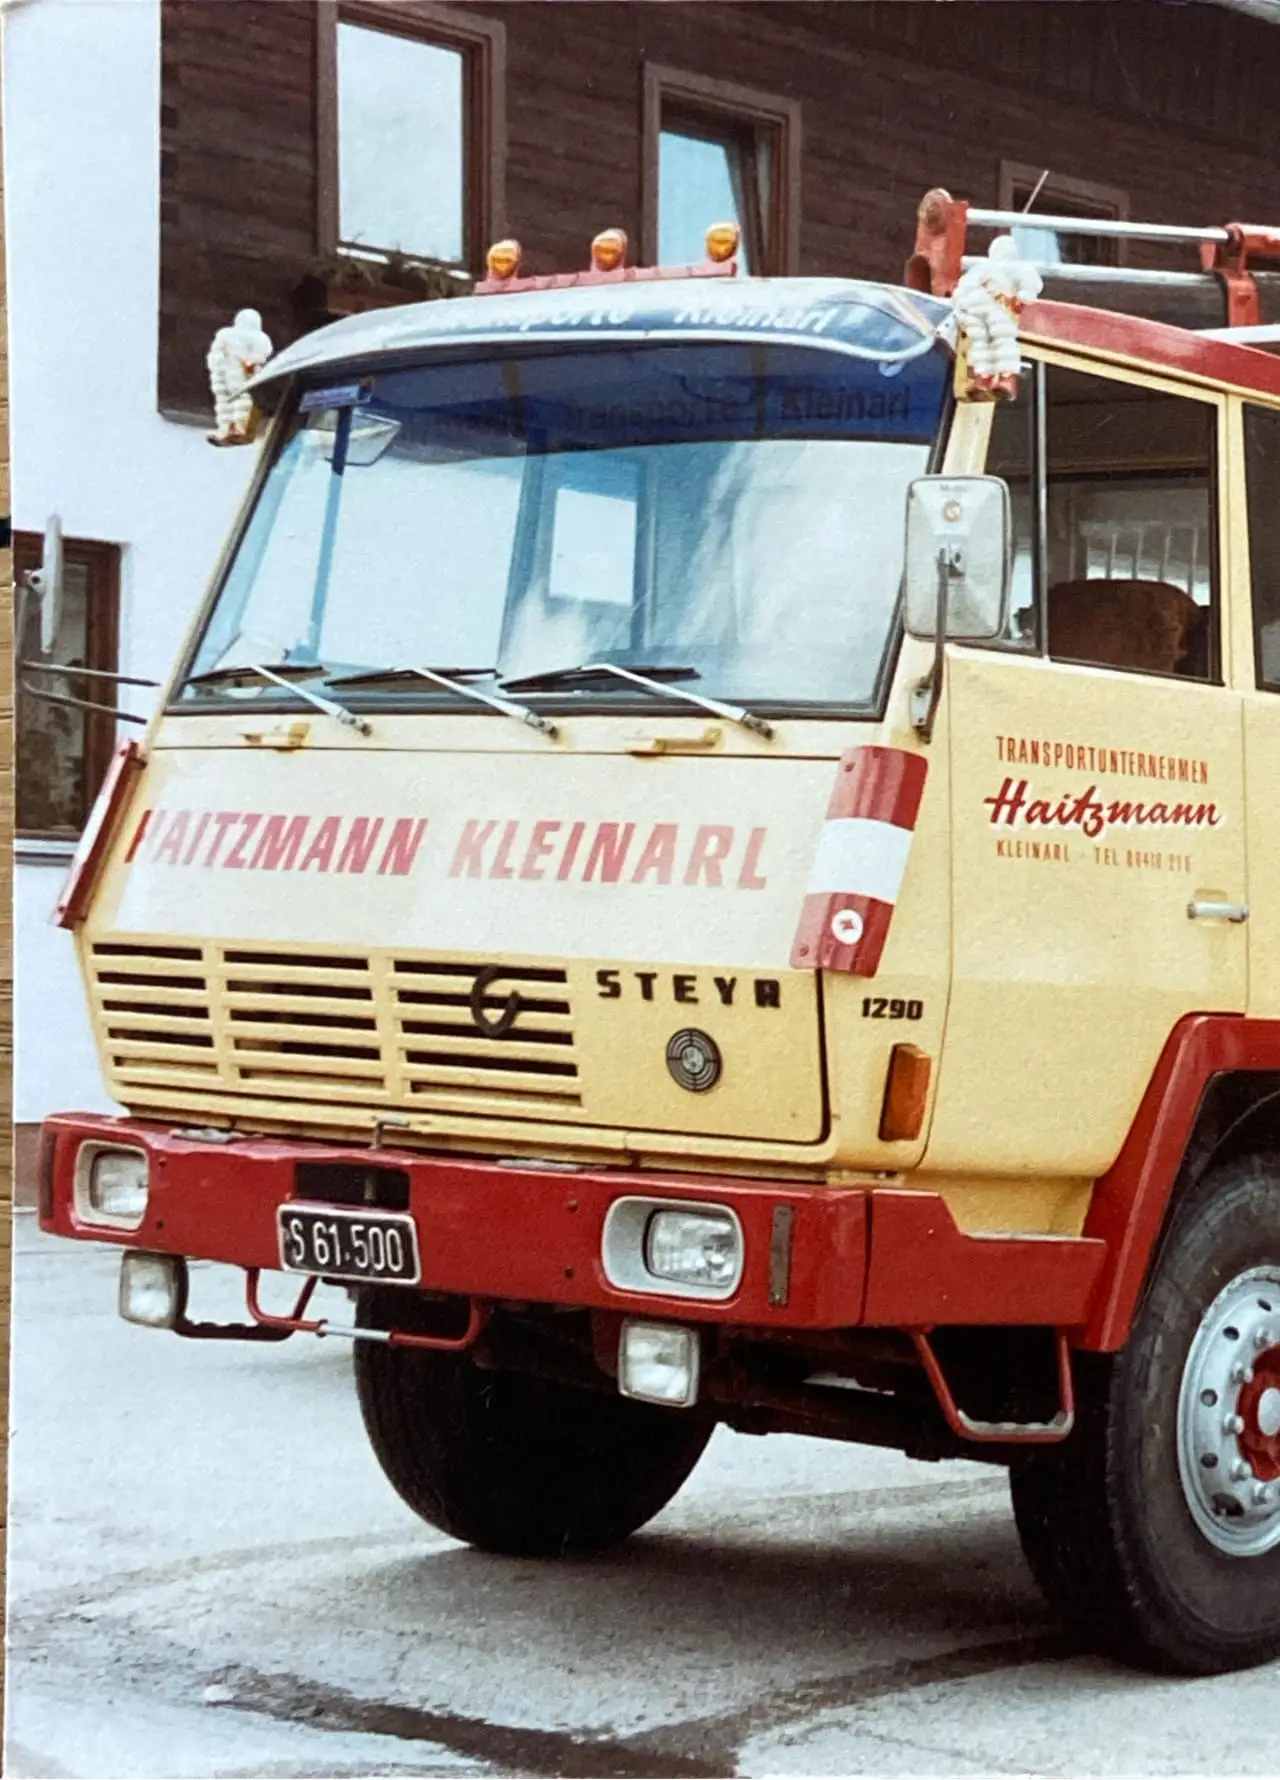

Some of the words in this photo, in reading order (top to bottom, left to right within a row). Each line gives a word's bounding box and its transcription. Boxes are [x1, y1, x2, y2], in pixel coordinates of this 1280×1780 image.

[996, 735, 1208, 784] TRANSPORTUNTERNEHMEN
[983, 777, 1221, 837] Haitzmann
[448, 818, 767, 891] KLEINARL
[996, 839, 1070, 863] KLEINARL
[1095, 847, 1119, 867] TEL
[597, 970, 780, 1008] STEYR
[862, 998, 924, 1021] 1290
[290, 1218, 305, 1263] S
